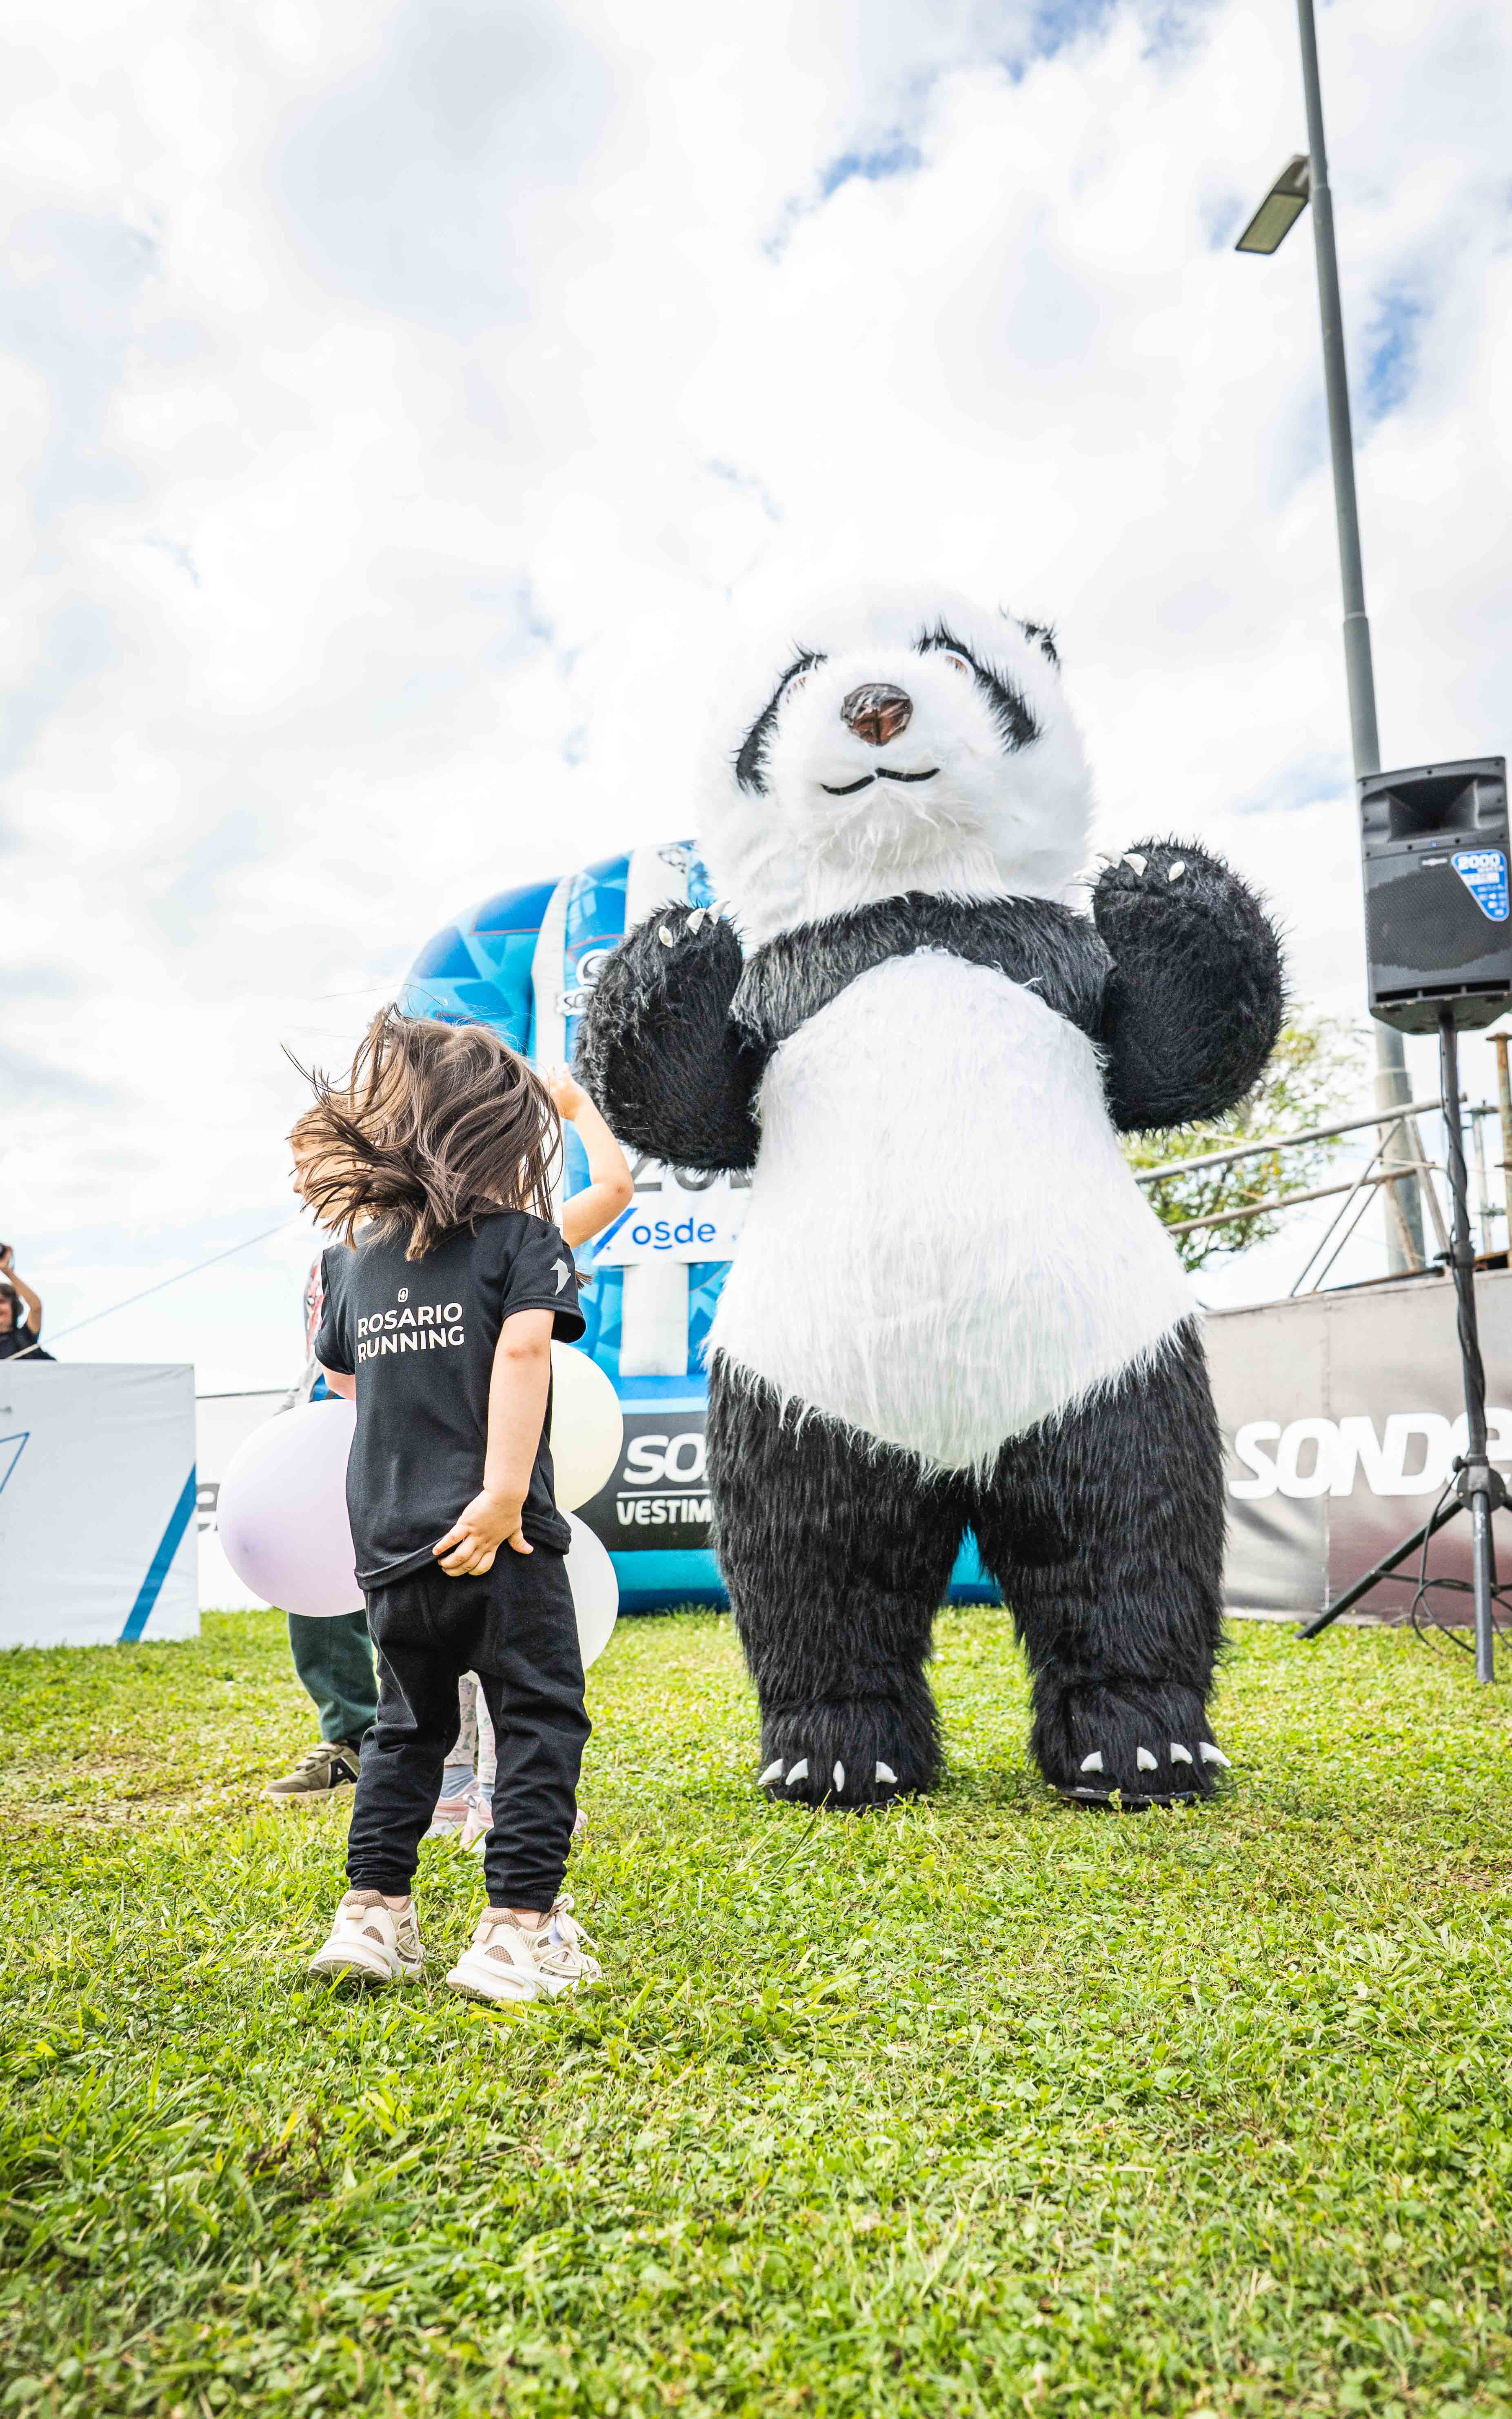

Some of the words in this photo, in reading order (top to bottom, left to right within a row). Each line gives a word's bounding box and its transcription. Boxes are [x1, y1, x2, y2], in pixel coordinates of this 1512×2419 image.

[632, 1217, 716, 1249] osde
[358, 1303, 462, 1338] ROSARIO
[357, 1326, 464, 1363] RUNNING
[623, 1433, 709, 1484] SO
